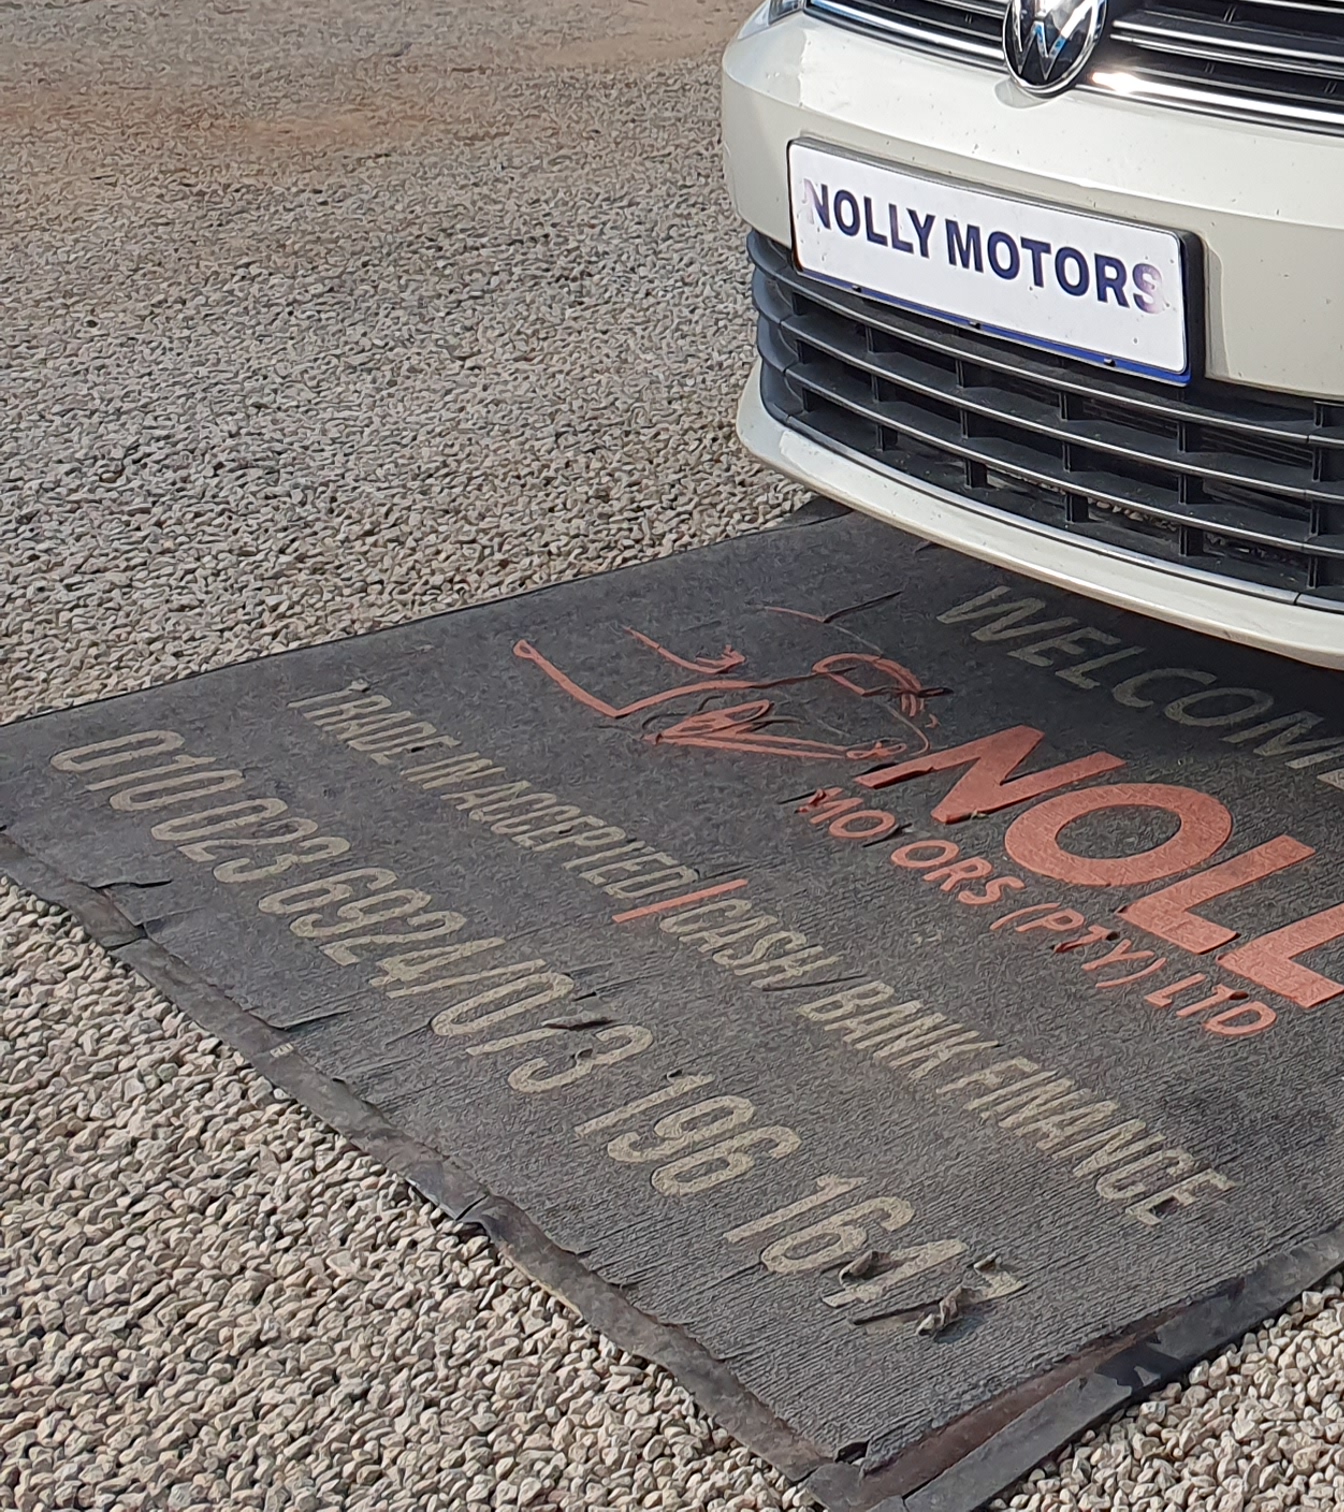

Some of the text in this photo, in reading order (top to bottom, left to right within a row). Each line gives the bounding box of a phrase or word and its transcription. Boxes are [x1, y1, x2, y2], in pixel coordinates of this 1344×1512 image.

[802, 178, 1167, 314] NOLLY MOTORS
[287, 680, 462, 765] TRADE
[400, 752, 505, 789] IN
[440, 780, 700, 899] ACCEPTED
[660, 898, 843, 988] CASH
[797, 787, 1277, 1037] MOORS (PTY) LTD
[799, 980, 999, 1080] BANK
[575, 1073, 801, 1196] 196
[937, 1056, 1237, 1226] FINANCE
